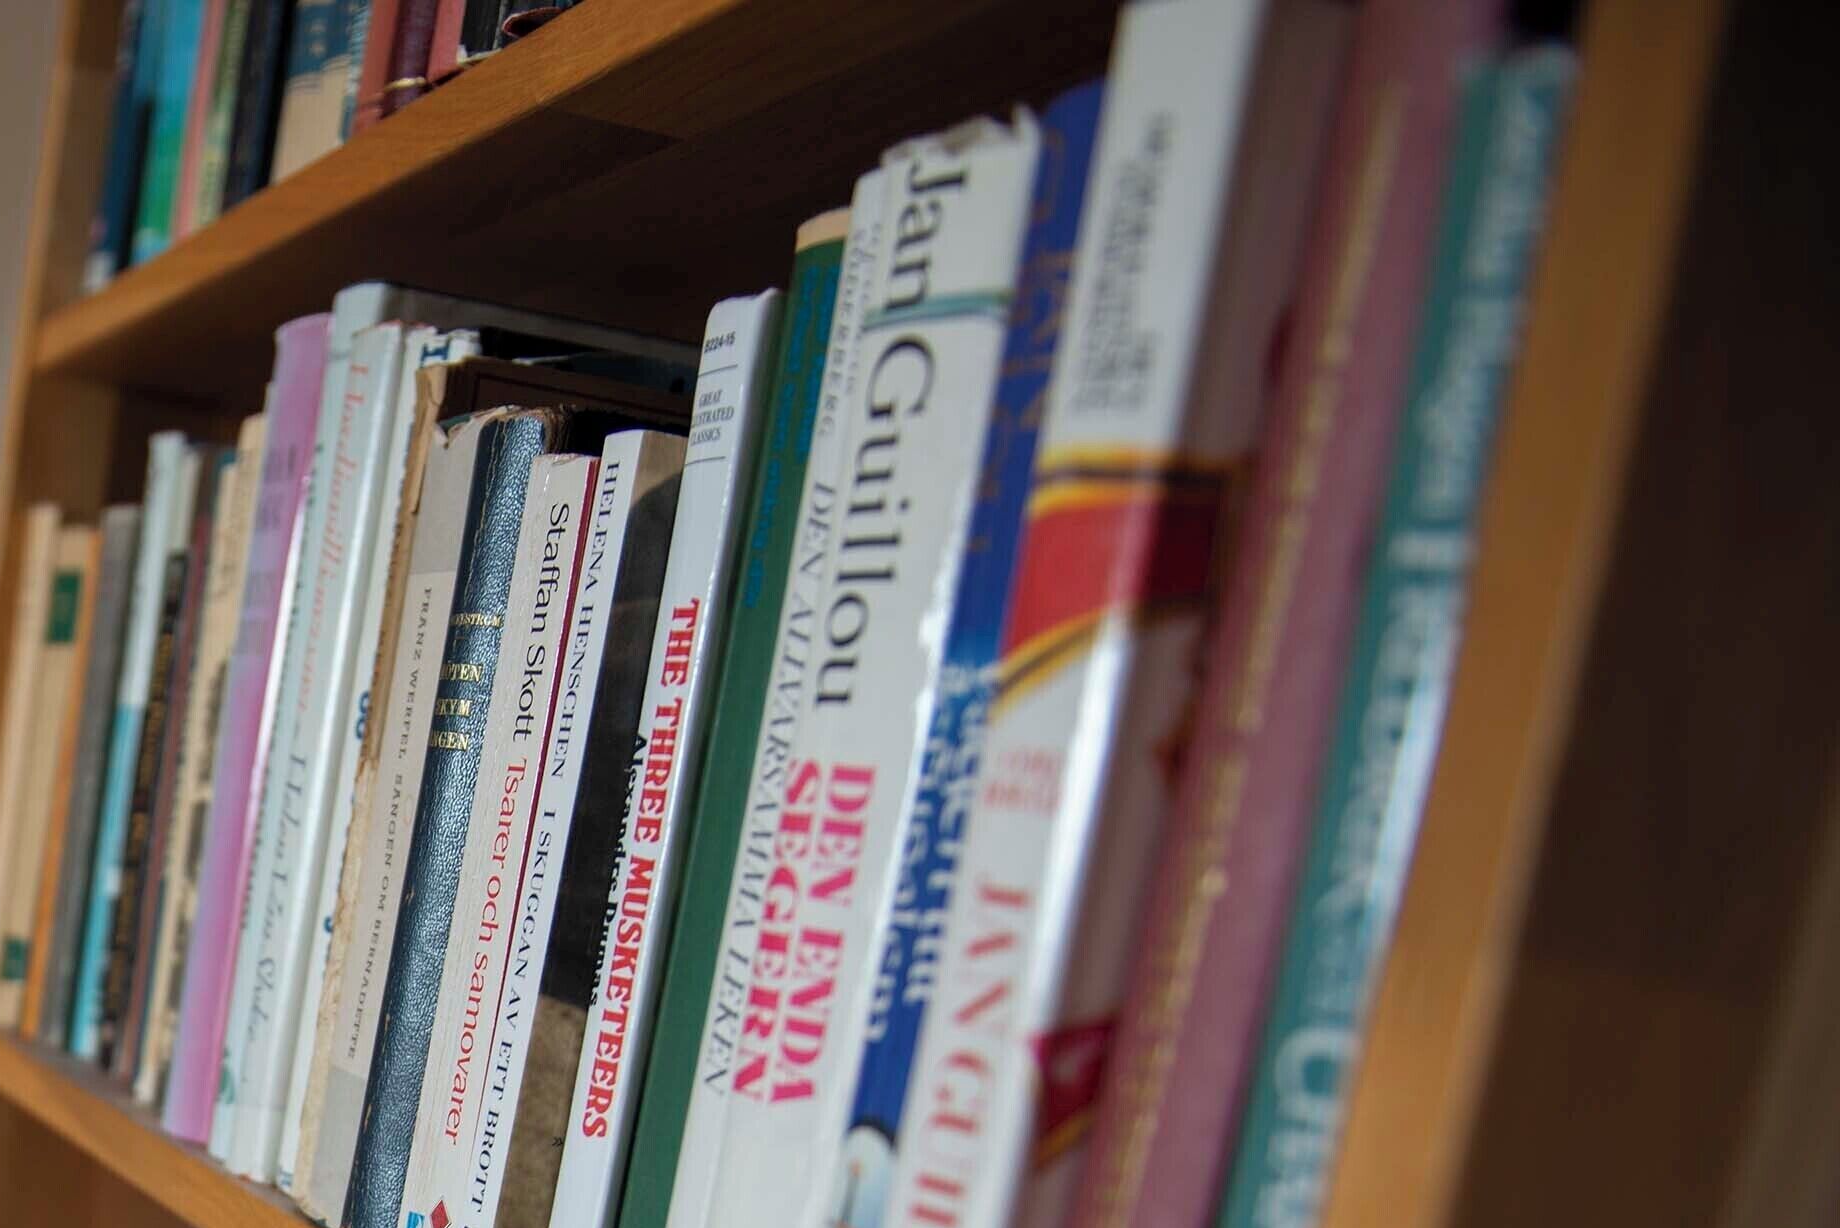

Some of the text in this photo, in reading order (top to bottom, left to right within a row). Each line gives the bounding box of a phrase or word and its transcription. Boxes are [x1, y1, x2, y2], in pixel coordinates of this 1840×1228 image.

[815, 162, 968, 711] Jan Guillou
[443, 502, 571, 1145] Staffan Skott Tsarer och samovarer
[469, 461, 621, 1217] HELENA HENSCHEN I SKUGGAN AV ETT BROTT
[582, 598, 699, 1140] THE THREE MUSKETEERS
[702, 945, 748, 1096] LEKEN
[729, 756, 821, 1103] SEGERN
[770, 763, 878, 1106] DEN ENDA
[953, 878, 1034, 1034] JAN
